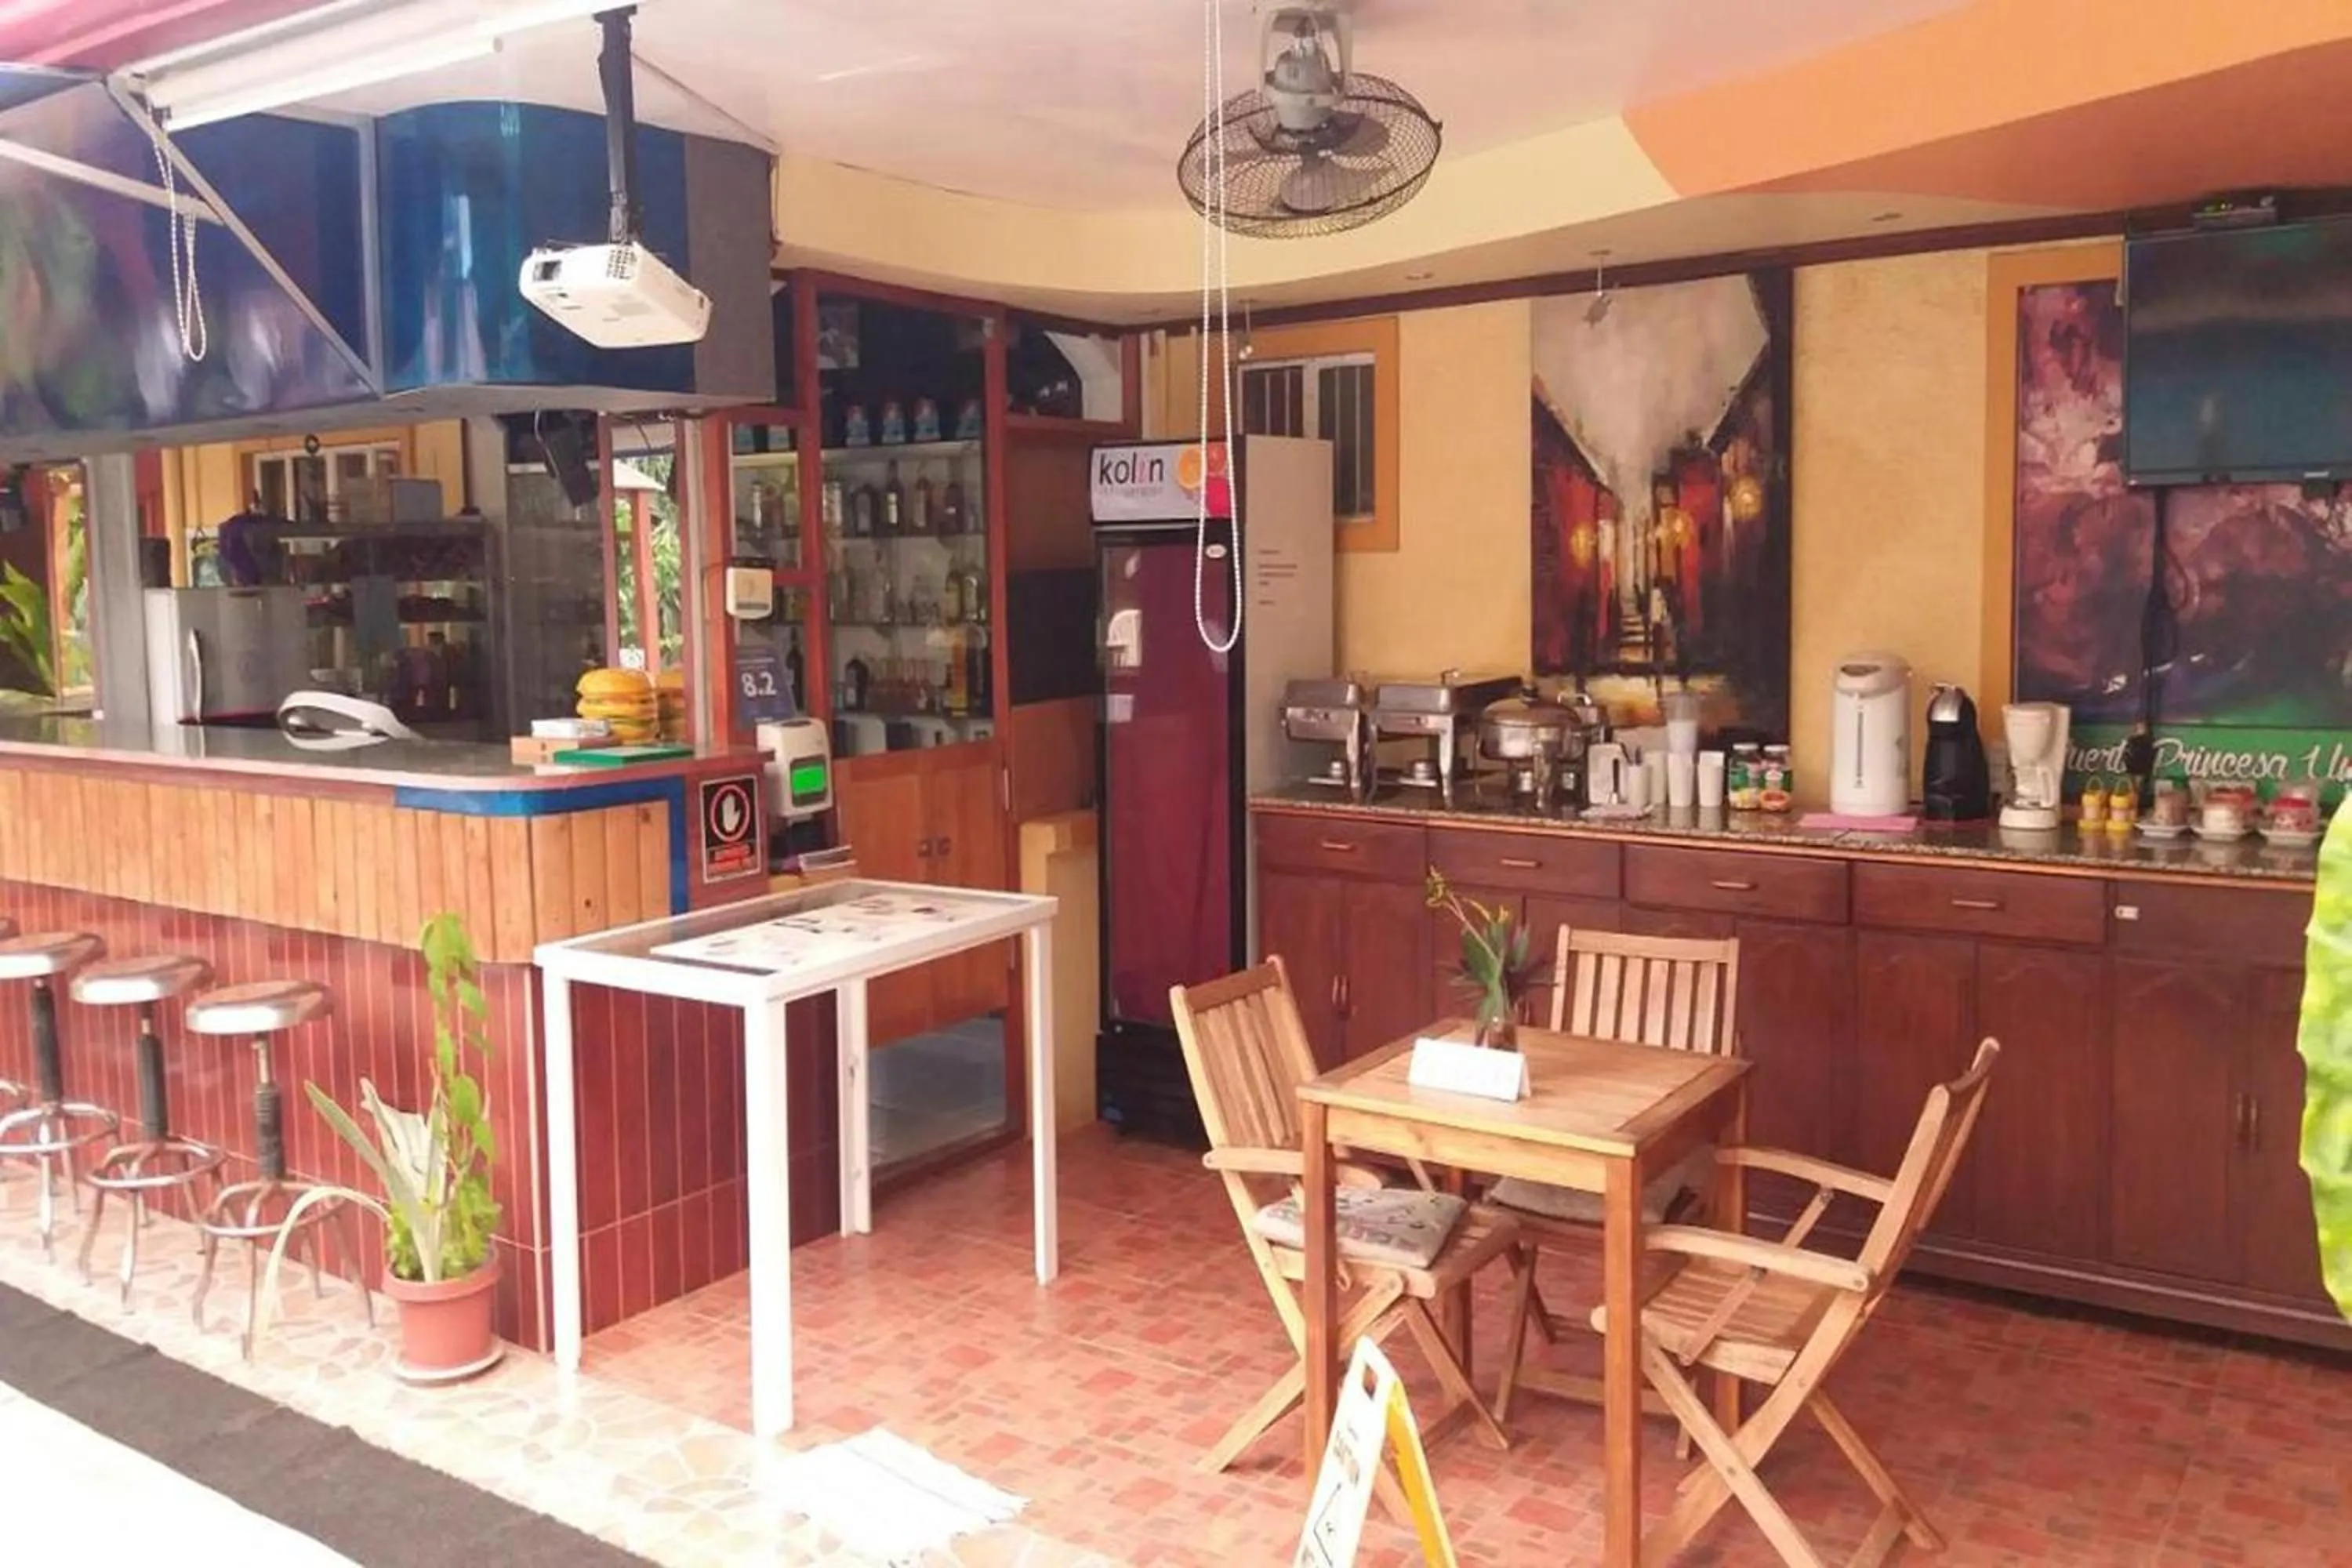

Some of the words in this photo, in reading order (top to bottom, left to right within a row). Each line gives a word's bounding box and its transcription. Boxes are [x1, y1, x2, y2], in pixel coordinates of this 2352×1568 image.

[1098, 452, 1164, 486] kolin
[741, 671, 778, 697] 8.2
[2066, 739, 2131, 775] uert
[2152, 738, 2288, 779] Princesa
